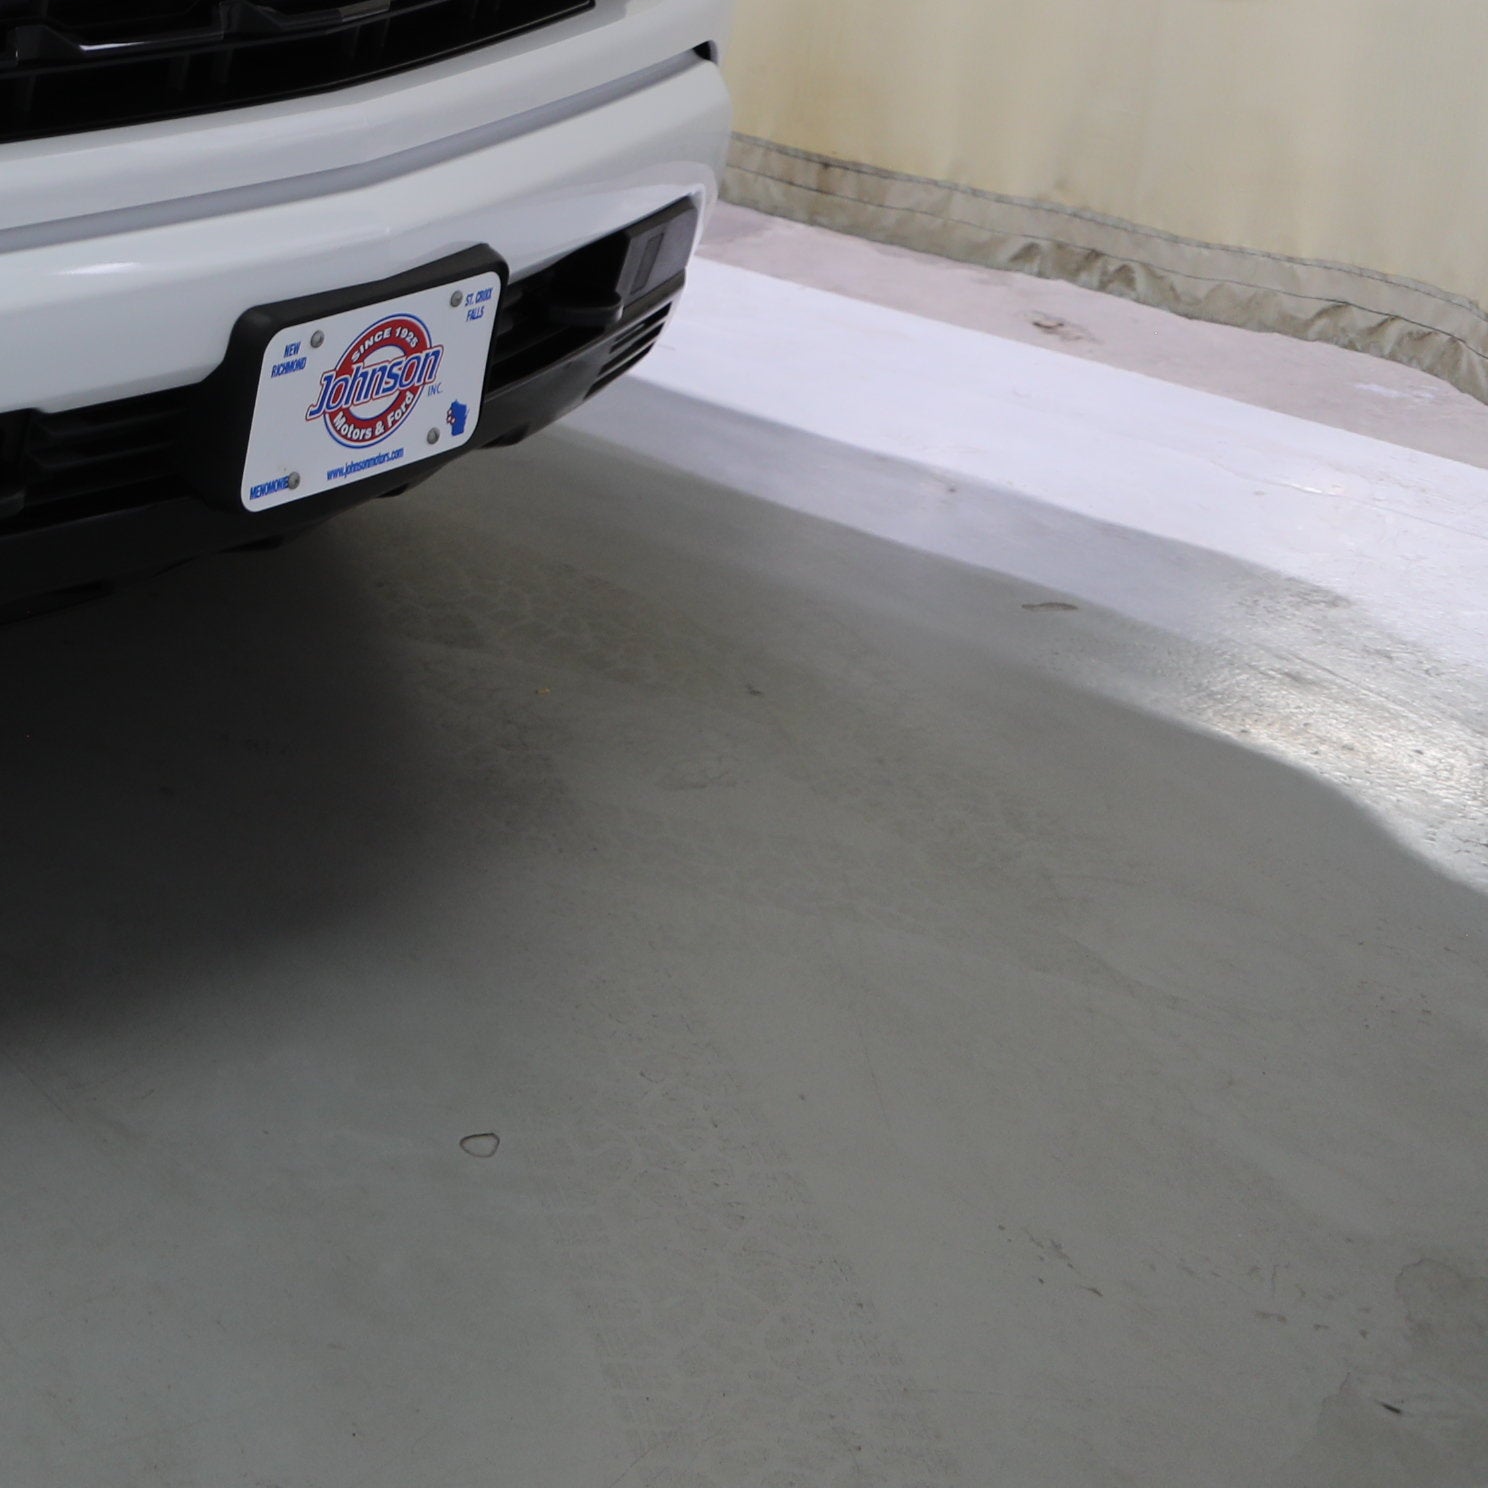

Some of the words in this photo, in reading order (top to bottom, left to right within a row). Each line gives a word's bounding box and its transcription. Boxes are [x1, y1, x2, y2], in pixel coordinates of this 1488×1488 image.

[466, 305, 485, 322] FALLS
[283, 341, 301, 358] NEW
[351, 327, 393, 362] SINCE
[394, 326, 419, 348] 1925
[306, 346, 442, 419] Johnson
[333, 411, 373, 440] Motors
[374, 421, 386, 435] &
[386, 391, 415, 428] Ford
